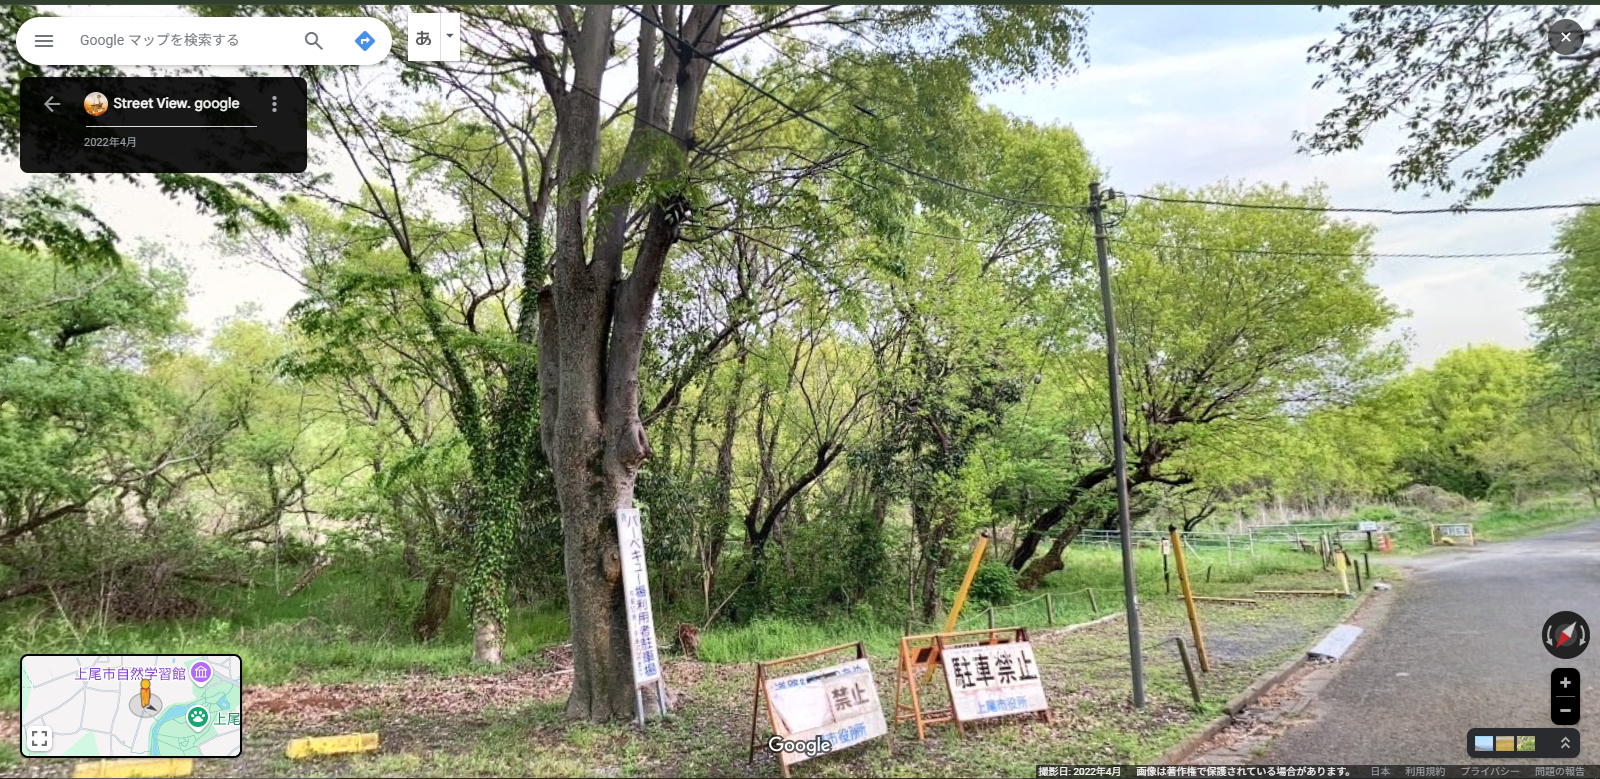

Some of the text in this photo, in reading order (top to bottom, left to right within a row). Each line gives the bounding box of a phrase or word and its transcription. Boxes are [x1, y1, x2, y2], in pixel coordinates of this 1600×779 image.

[951, 649, 1038, 689] 駐車禁止
[831, 682, 870, 712] 禁止
[977, 694, 1029, 714] 上尾市役所
